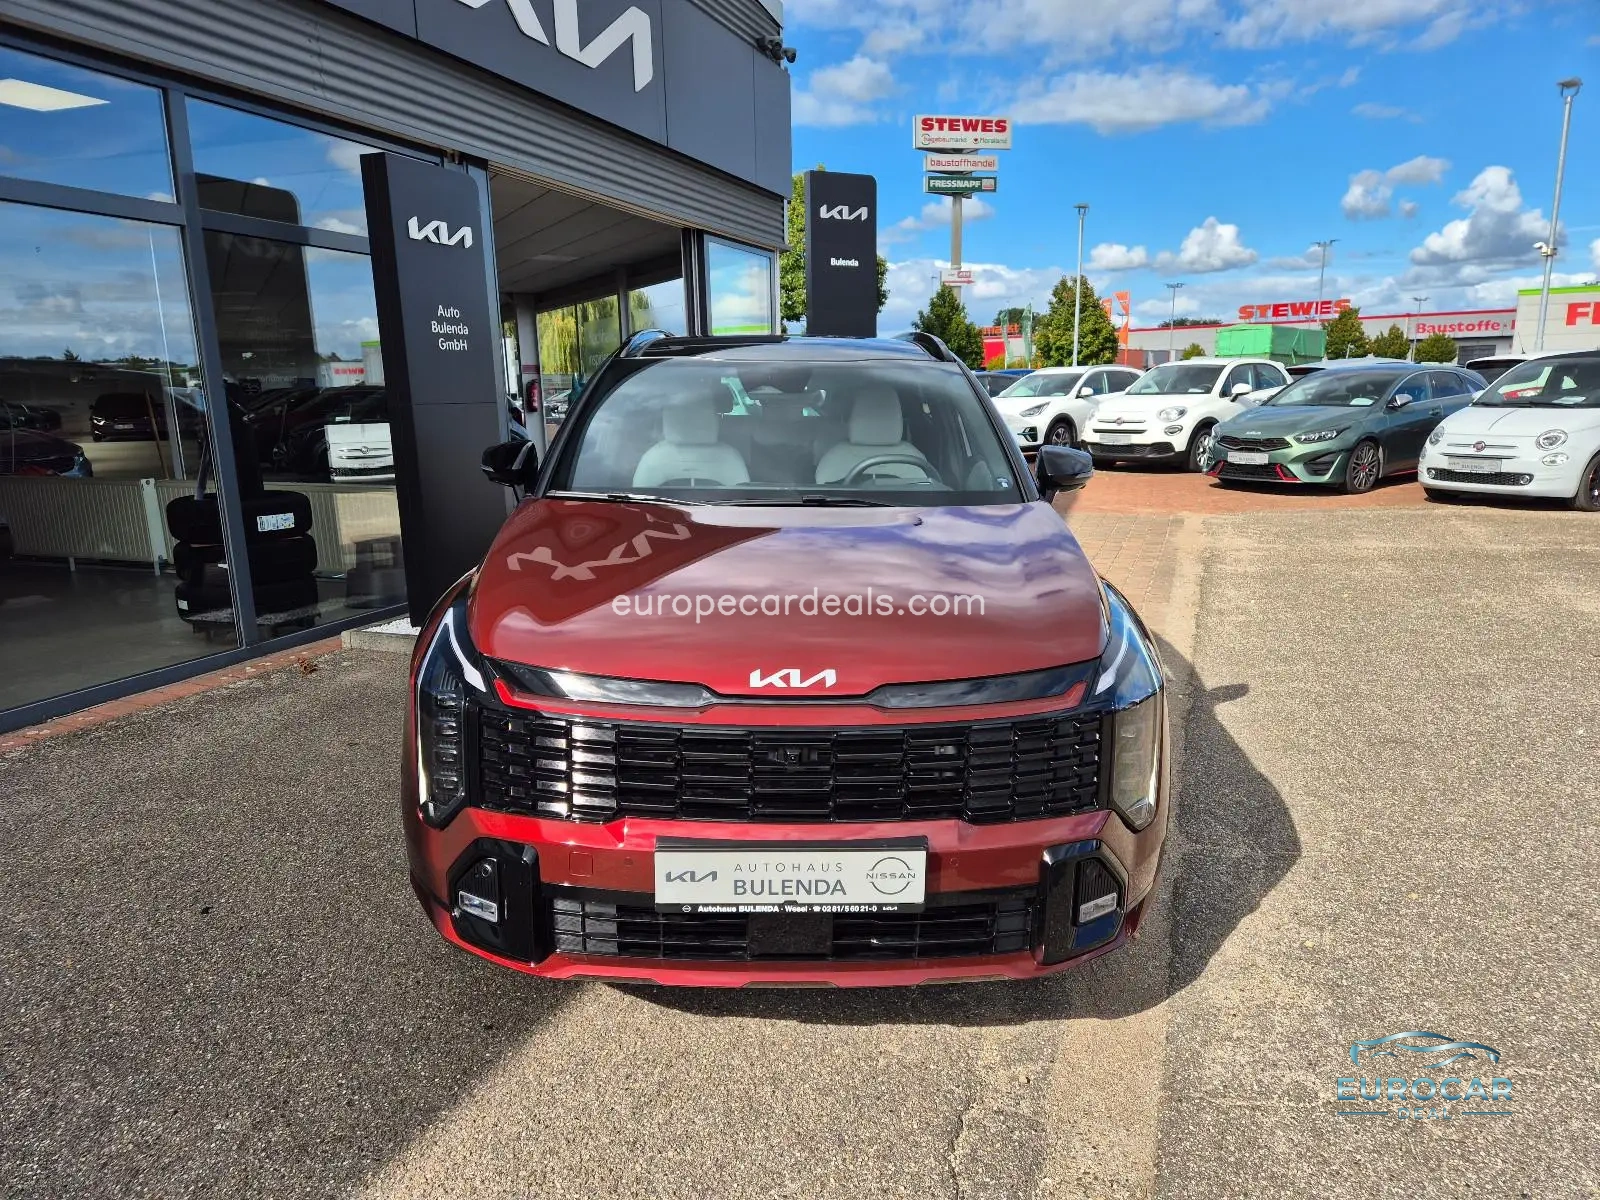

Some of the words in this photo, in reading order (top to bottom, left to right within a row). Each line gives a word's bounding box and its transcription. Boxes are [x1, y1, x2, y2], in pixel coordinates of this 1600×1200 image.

[921, 117, 1007, 132] STEWES
[930, 158, 995, 168] baustoffhandel
[929, 179, 981, 188] FRESSNAPF
[819, 203, 868, 221] KIA
[407, 215, 473, 248] KIA
[830, 257, 859, 267] Bulenda
[437, 304, 460, 318] Auto
[1238, 298, 1351, 319] STEWES
[431, 320, 469, 335] Bulenda
[1416, 319, 1500, 333] Baustoffe
[438, 337, 468, 351] GmbH
[749, 668, 837, 689] KIA
[733, 862, 843, 873] AUTOHAUS
[665, 870, 718, 883] KIA
[865, 872, 916, 880] NISSAN
[733, 879, 847, 896] BULENDA
[698, 905, 737, 913] Autohaus
[738, 905, 780, 913] BULENDA
